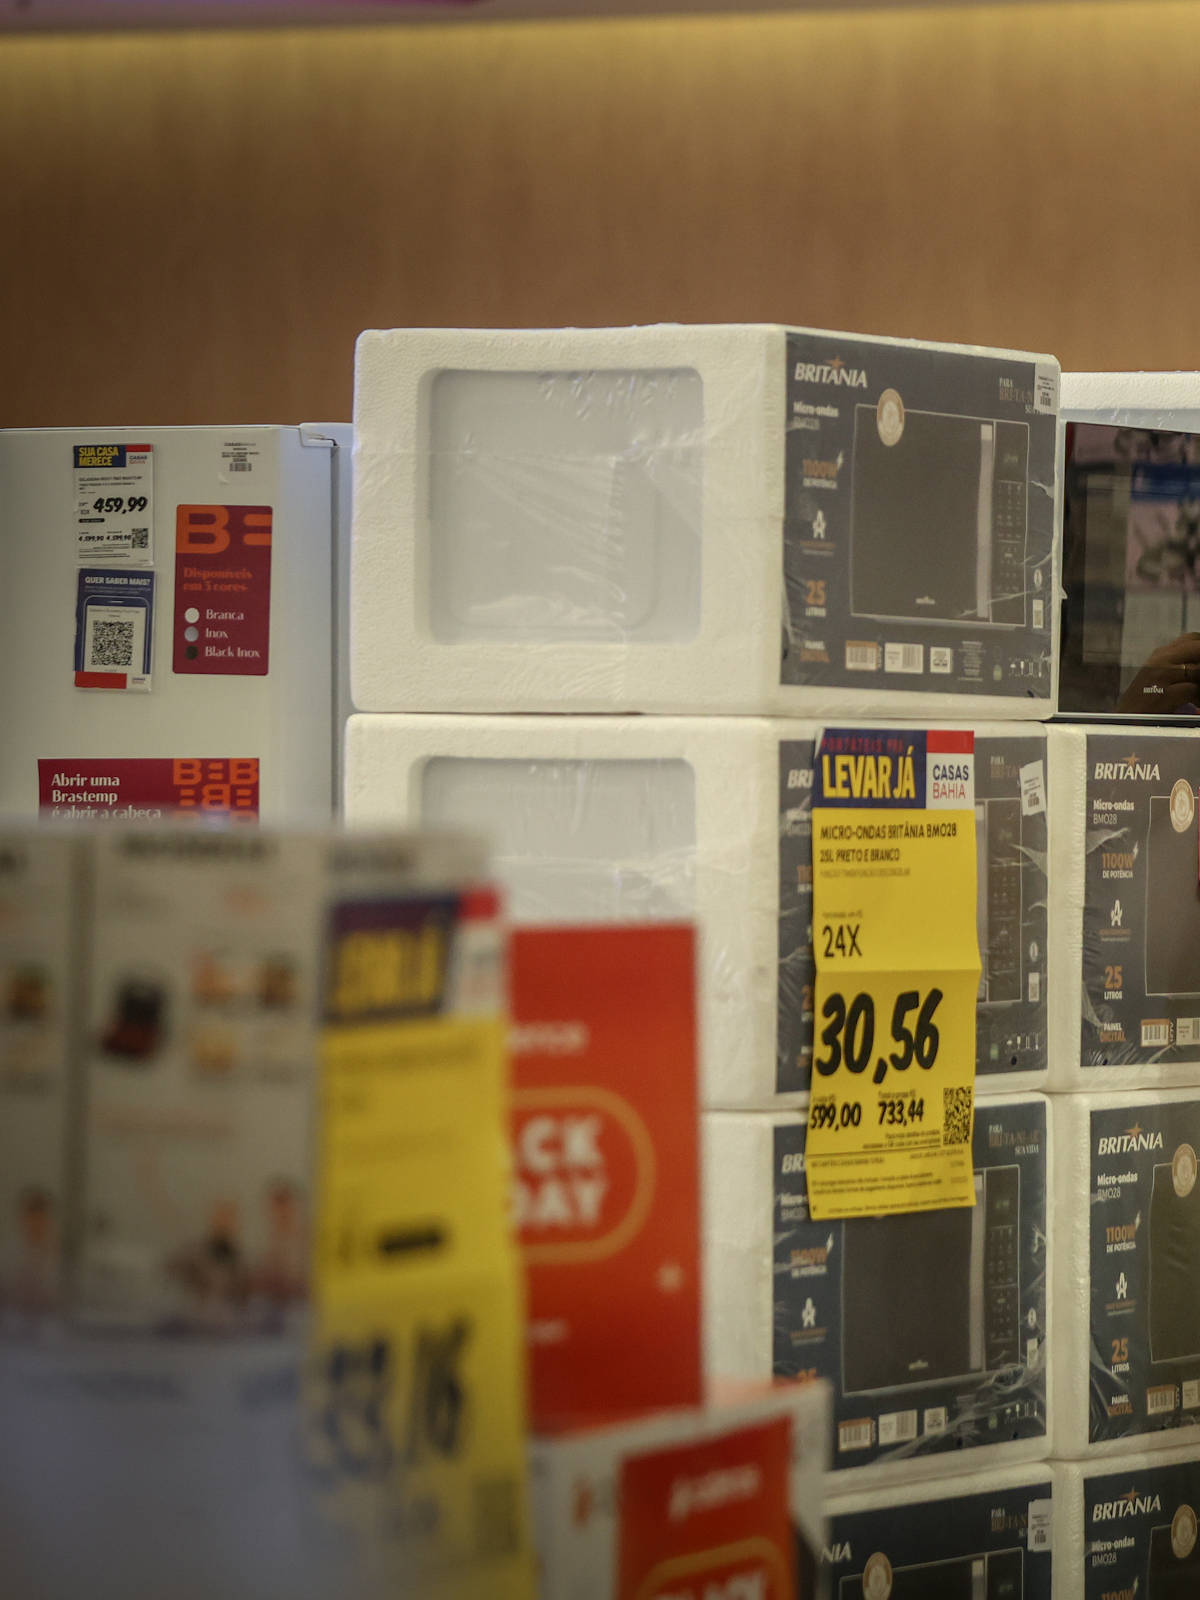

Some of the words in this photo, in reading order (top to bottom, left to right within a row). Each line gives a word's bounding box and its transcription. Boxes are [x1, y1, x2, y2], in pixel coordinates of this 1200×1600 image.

[79, 447, 96, 456] SUA
[97, 447, 119, 457] CASA
[79, 456, 113, 466] MERECE
[93, 496, 148, 515] 459,99
[85, 576, 105, 584] QUER
[105, 577, 129, 585] SABER
[806, 579, 827, 607] 25
[206, 609, 245, 620] Branca
[206, 628, 229, 639] Inox
[205, 646, 235, 657] Black
[237, 647, 261, 658] Inox
[822, 754, 892, 798] LEVAR
[892, 745, 916, 798] JÁ
[933, 764, 969, 781] CASAS
[1094, 763, 1161, 780] BRITANIA
[51, 773, 88, 786] Abrir
[90, 776, 120, 787] uma
[52, 789, 118, 805] Brastemp
[933, 782, 966, 799] BAHIA
[63, 805, 98, 819] abrir
[1093, 799, 1135, 811] Micro-ondas
[820, 824, 886, 840] MICRO-ONDAS
[887, 821, 924, 839] BRITÂNIA
[836, 849, 862, 862] PRETO
[864, 849, 869, 862] E
[870, 848, 900, 861] BRANCO
[1102, 853, 1135, 869] 1100W
[1102, 870, 1109, 879] DE
[822, 924, 863, 958] 24X
[1104, 965, 1123, 990] 25
[1104, 991, 1123, 1000] LITROS
[815, 988, 943, 1084] 30,56
[810, 1101, 862, 1131] 599,00
[878, 1098, 925, 1126] 733,44
[1098, 1131, 1163, 1155] BRITANIA
[1097, 1171, 1138, 1186] Micro-ondas
[1106, 1224, 1137, 1243] 1100W
[1112, 1337, 1129, 1363] 25
[1112, 1362, 1130, 1374] LITROS
[1093, 1494, 1161, 1523] BRITANIA
